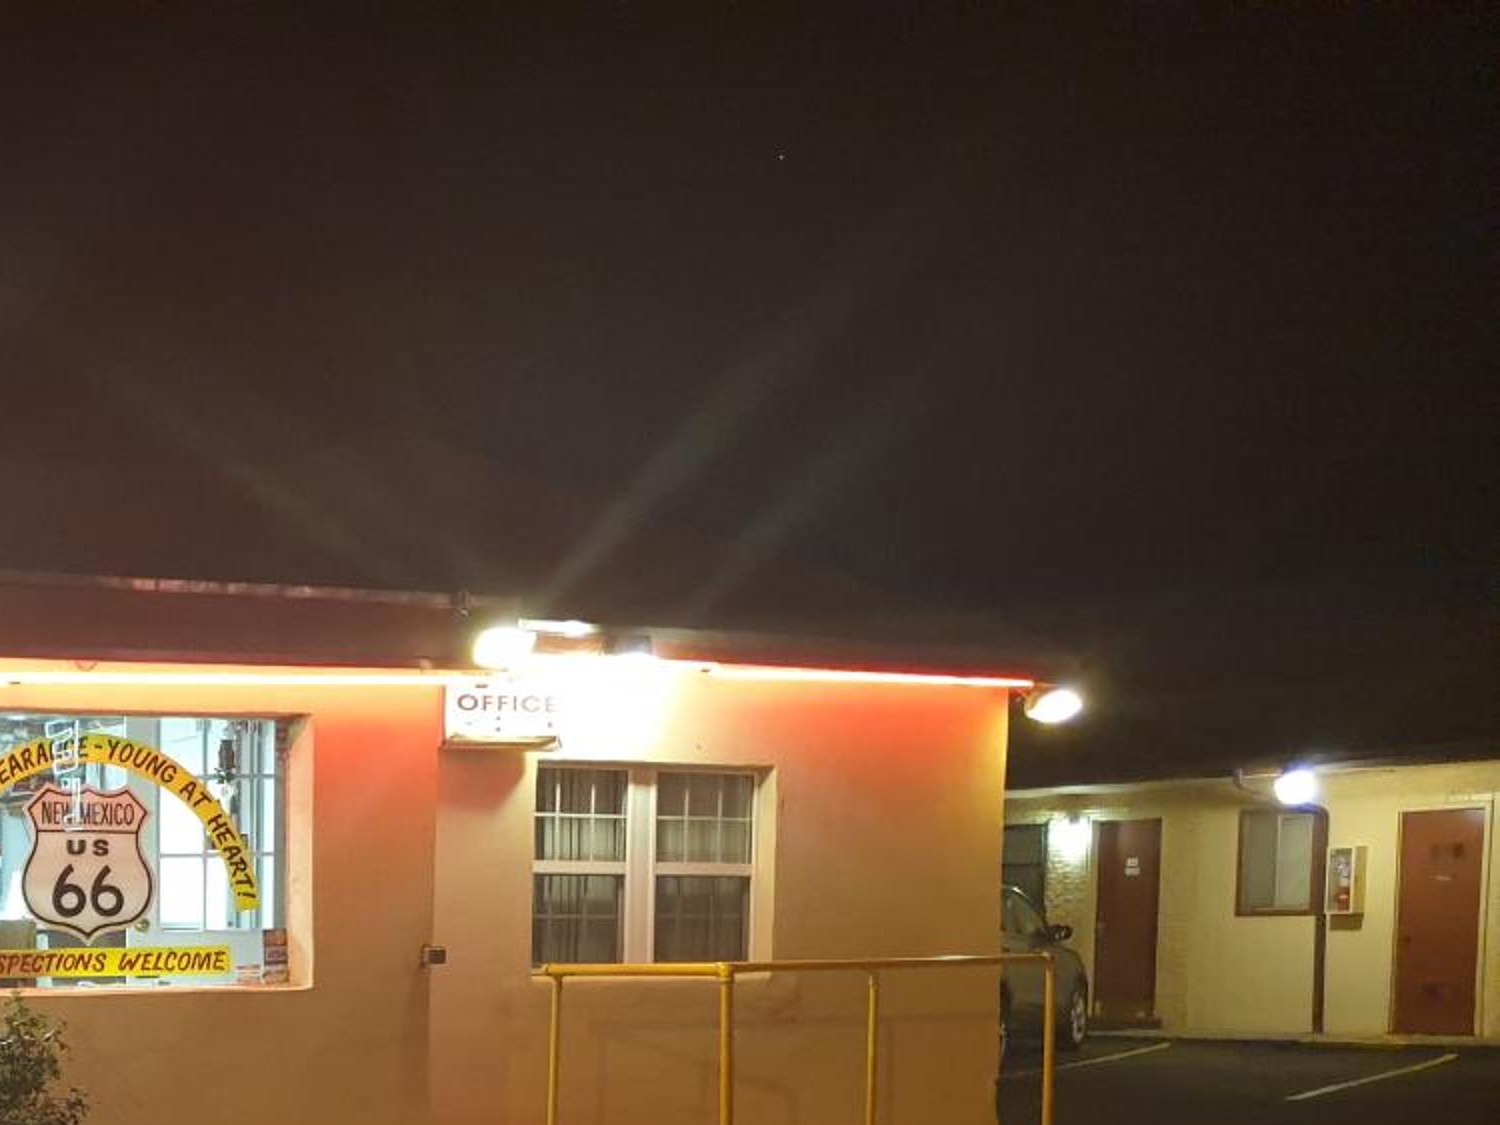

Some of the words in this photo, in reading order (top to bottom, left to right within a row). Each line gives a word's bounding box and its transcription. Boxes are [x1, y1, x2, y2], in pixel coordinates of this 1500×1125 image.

[457, 694, 556, 713] OFFICE
[80, 801, 134, 826] MEXICO
[107, 739, 177, 783] YOUNG
[179, 782, 212, 807] AT
[208, 814, 256, 898] HEART!
[52, 864, 124, 917] 66
[118, 950, 226, 971] WELCOME
